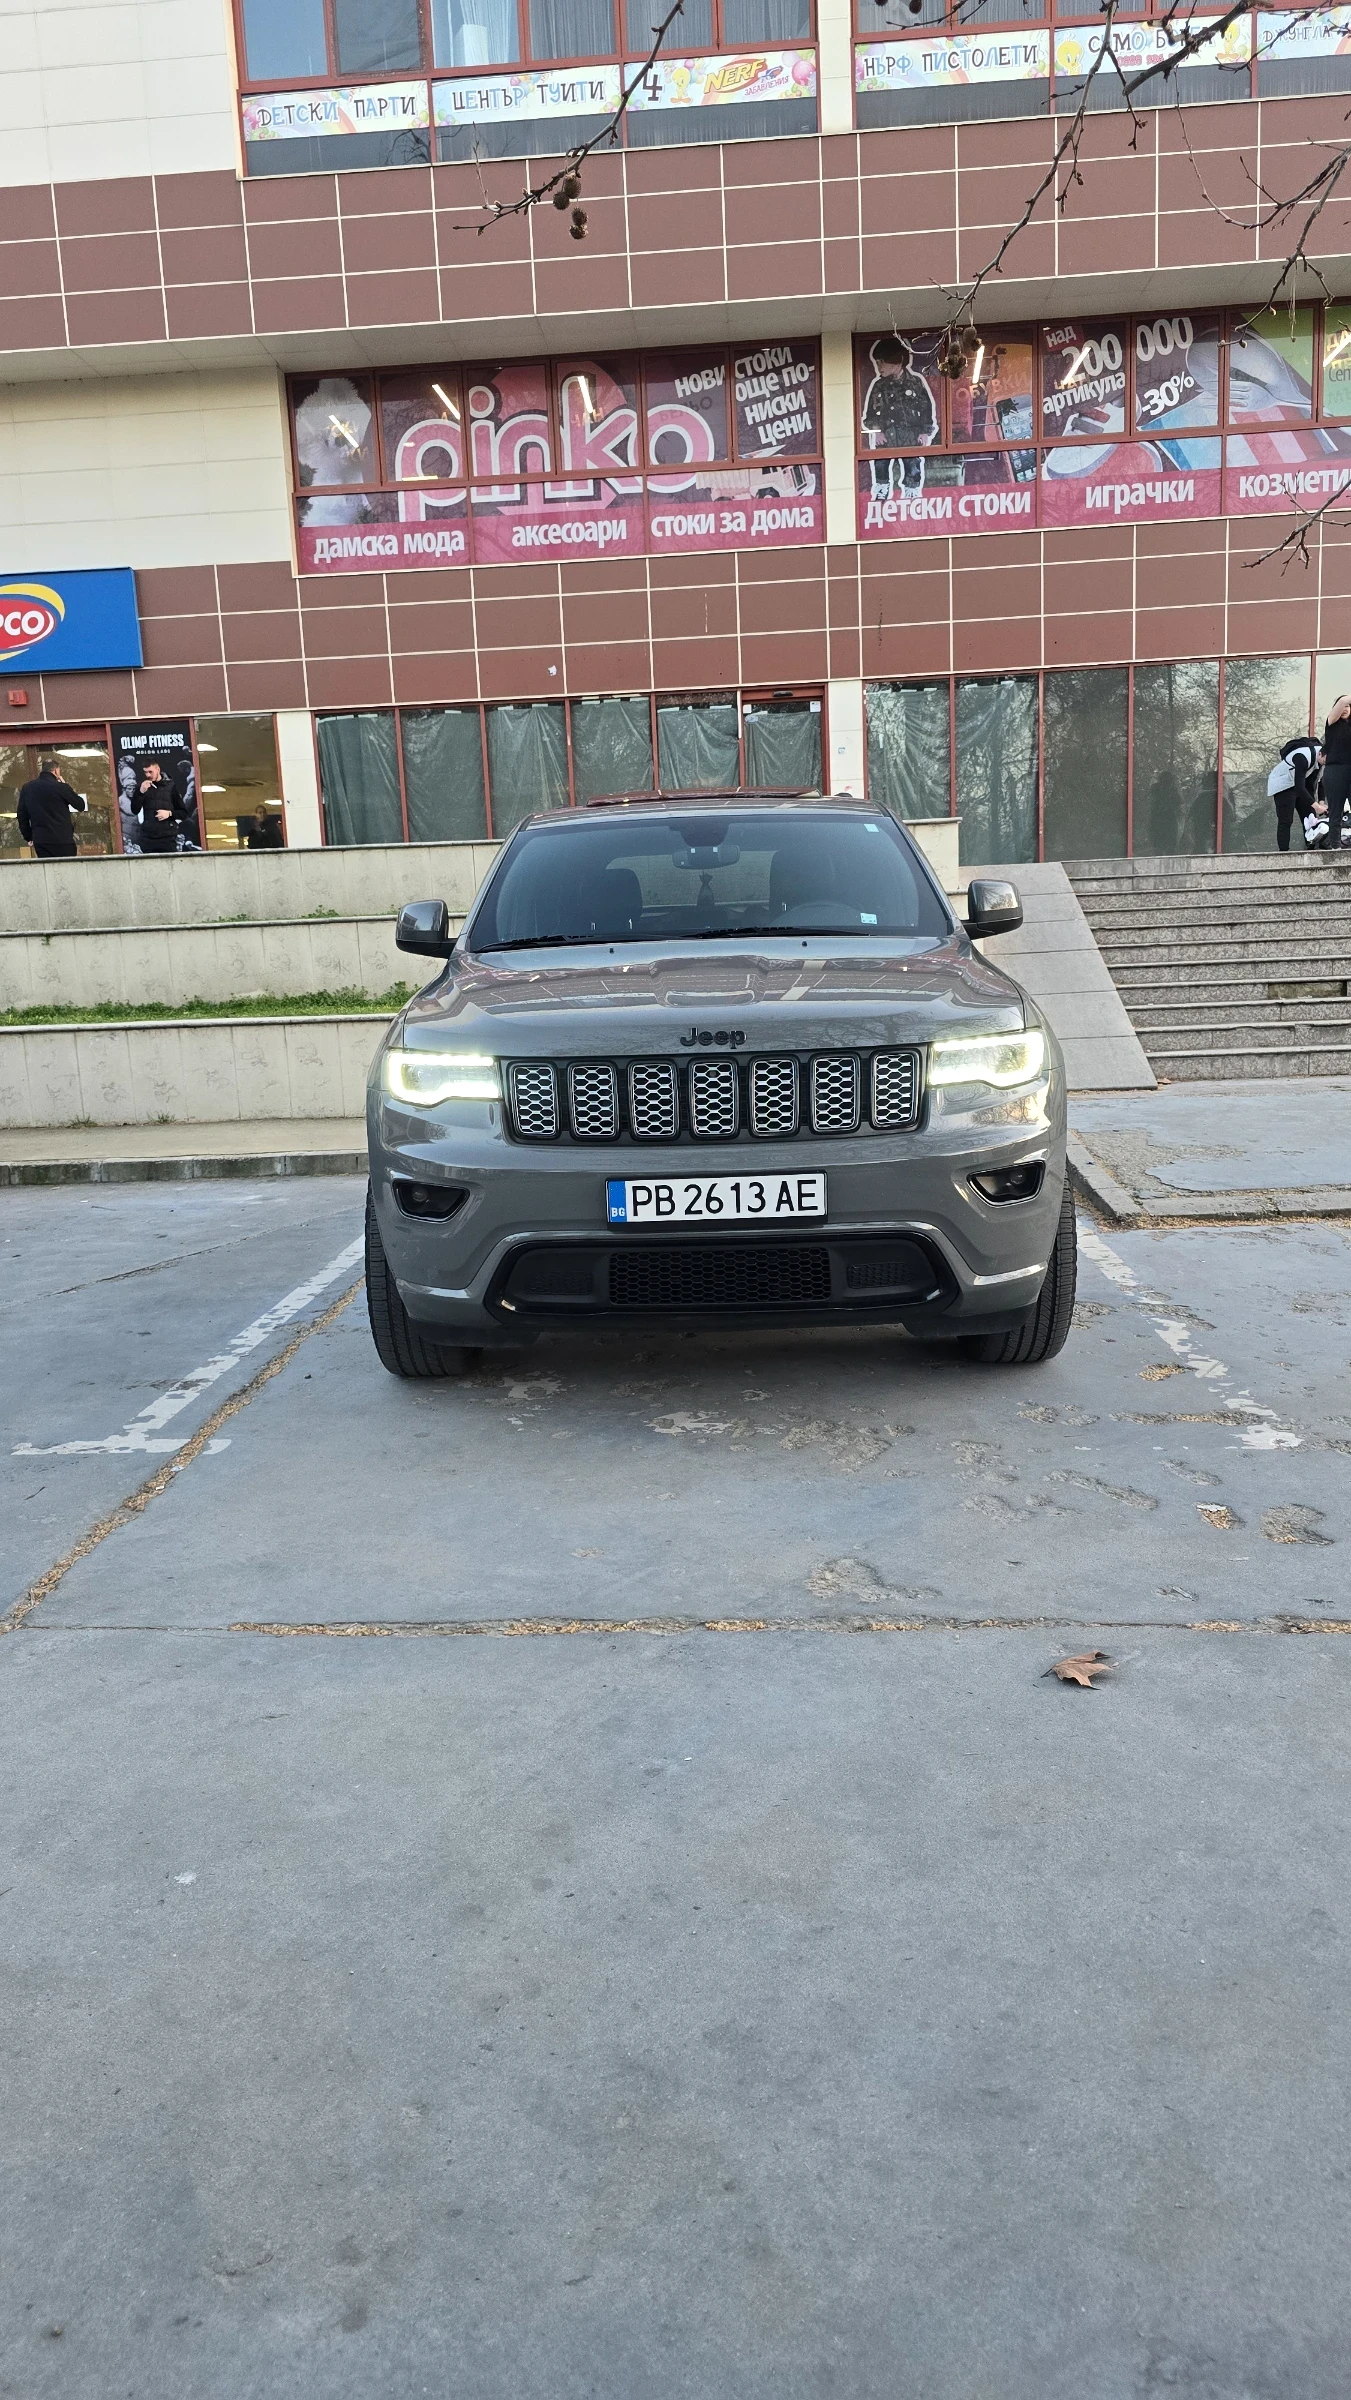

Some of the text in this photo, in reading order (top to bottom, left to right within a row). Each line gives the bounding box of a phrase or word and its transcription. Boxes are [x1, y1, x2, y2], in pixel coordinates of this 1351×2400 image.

[1088, 30, 1145, 54] СМО
[704, 58, 767, 94] NERF
[864, 44, 1037, 78] НЪРФ ПИСТОЛЕТИ
[452, 81, 604, 111] ЦЕНТЪР ТУИТИ
[744, 75, 790, 96] ЗАБАВЛЕНИЯ
[257, 96, 416, 127] ДЕТСКИ ПАРТИ
[1046, 325, 1077, 348] над
[1061, 333, 1122, 379] 200
[1136, 317, 1193, 362] 000
[735, 347, 792, 379] стоки
[744, 389, 807, 425] ниски
[1042, 372, 1126, 416] артикула
[1142, 371, 1195, 416] -30%
[758, 411, 812, 446] цени
[395, 374, 715, 523] pinko
[1085, 479, 1194, 514] играчки
[1239, 468, 1351, 498] козмети
[650, 506, 815, 538] стоки за дома
[864, 491, 1031, 529] детски стоки
[313, 529, 465, 564] дамска мода
[511, 519, 627, 549] аксесоари
[0, 610, 45, 636] CO
[120, 733, 184, 750] OLIMP FITNESS
[680, 1027, 747, 1049] Jeep
[611, 1207, 626, 1217] BG
[631, 1179, 819, 1217] PB 2613 AE
